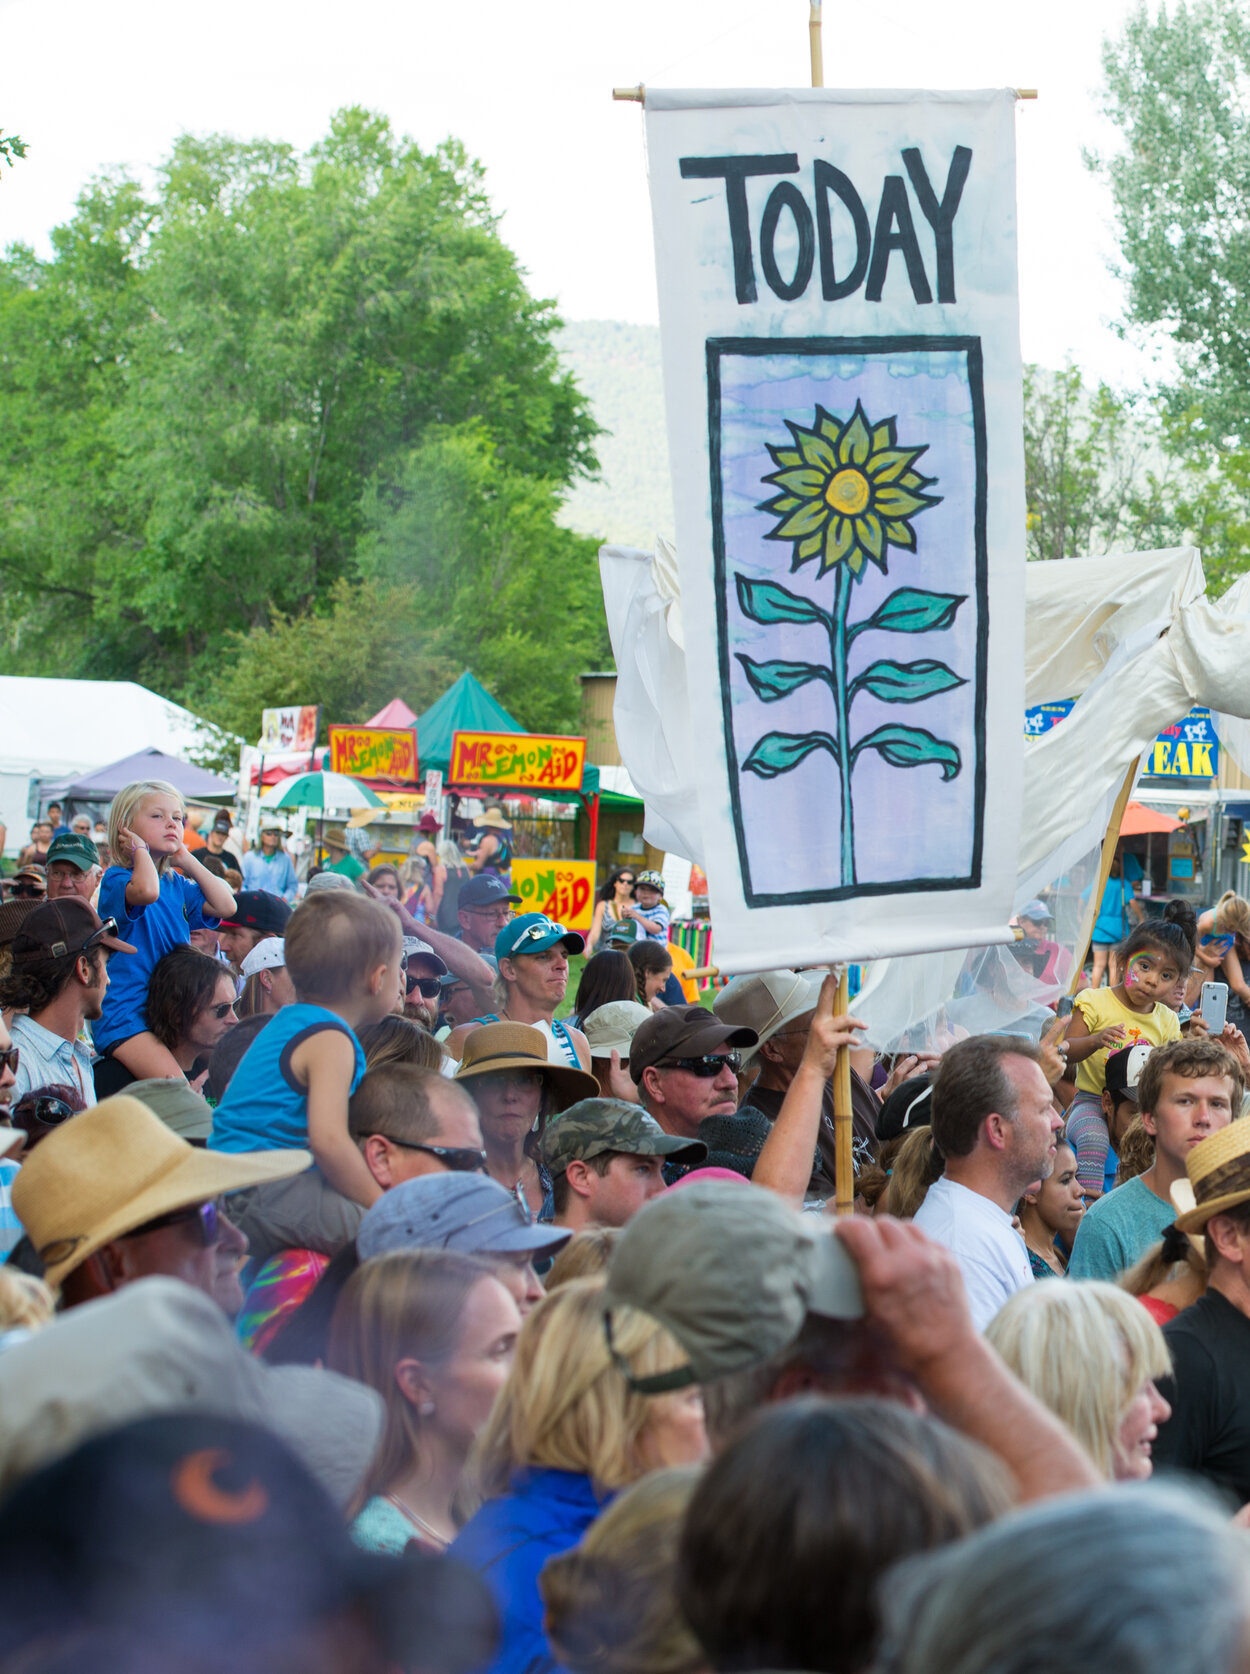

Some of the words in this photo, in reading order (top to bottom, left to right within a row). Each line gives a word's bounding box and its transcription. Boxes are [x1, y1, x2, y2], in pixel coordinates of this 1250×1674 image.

[679, 145, 972, 305] TODAY
[335, 735, 359, 773] MR
[350, 736, 394, 773] LEMON
[456, 742, 494, 780] MR
[481, 744, 552, 780] LEMON
